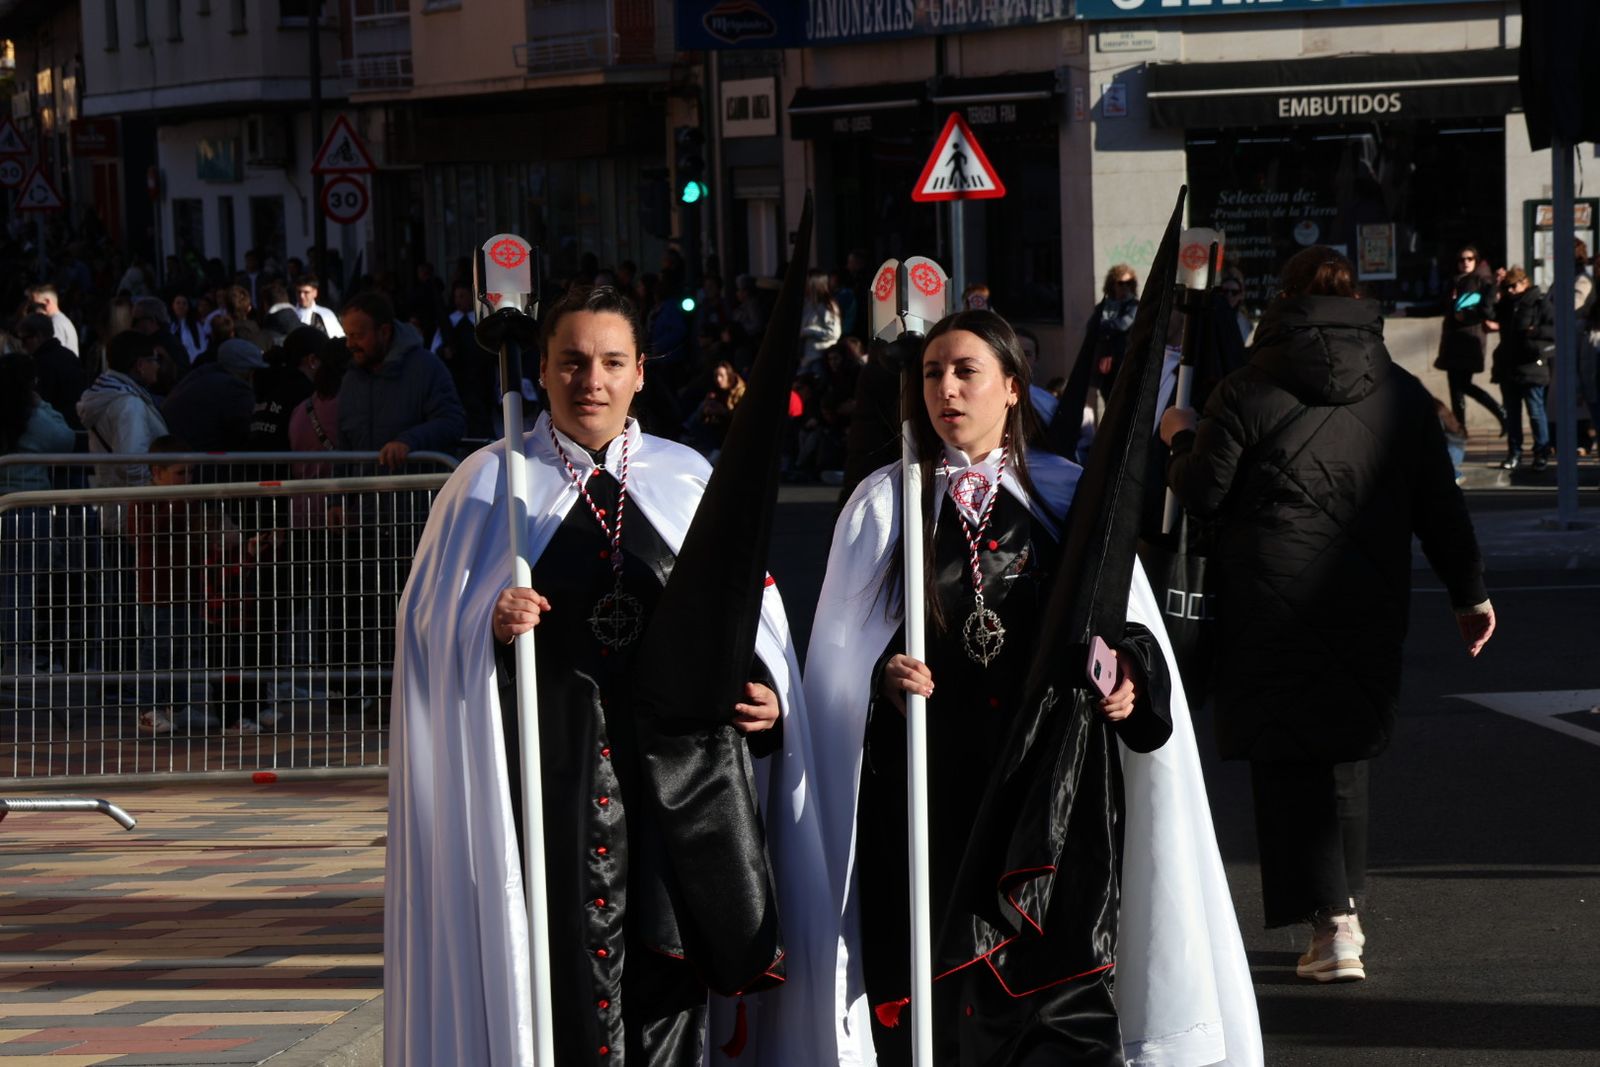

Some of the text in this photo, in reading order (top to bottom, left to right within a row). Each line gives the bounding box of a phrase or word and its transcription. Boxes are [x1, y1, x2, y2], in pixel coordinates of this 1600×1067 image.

[1278, 92, 1402, 118] EMBUTIDOS
[330, 192, 358, 209] 30
[1291, 187, 1317, 204] de:
